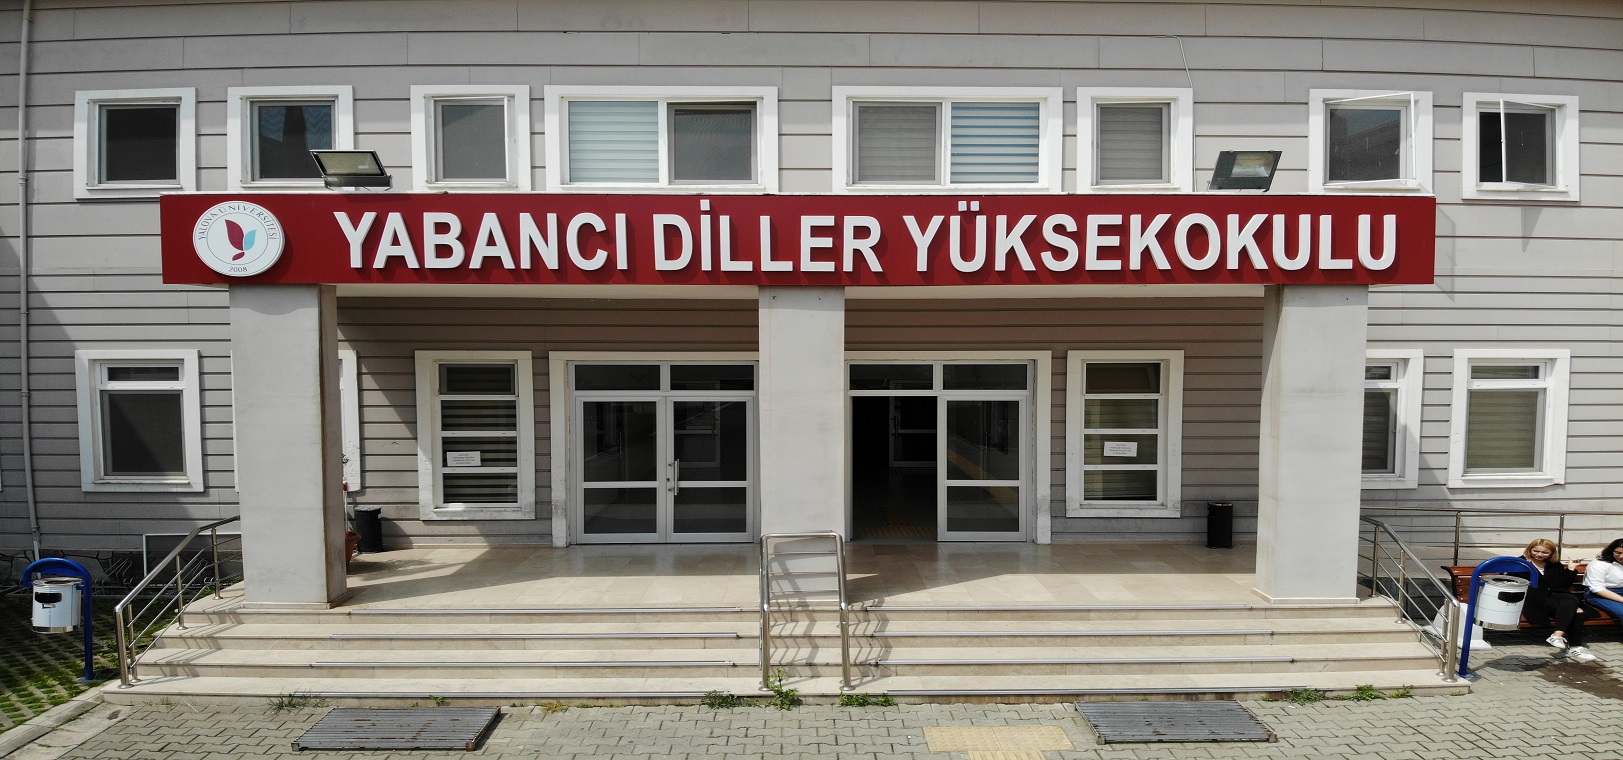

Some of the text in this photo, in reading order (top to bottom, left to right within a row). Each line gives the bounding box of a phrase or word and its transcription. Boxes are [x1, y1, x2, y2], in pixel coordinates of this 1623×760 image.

[198, 213, 218, 240] YALOVA
[333, 198, 1397, 273] YABANCI DİLLER YÜKSEKOKULU
